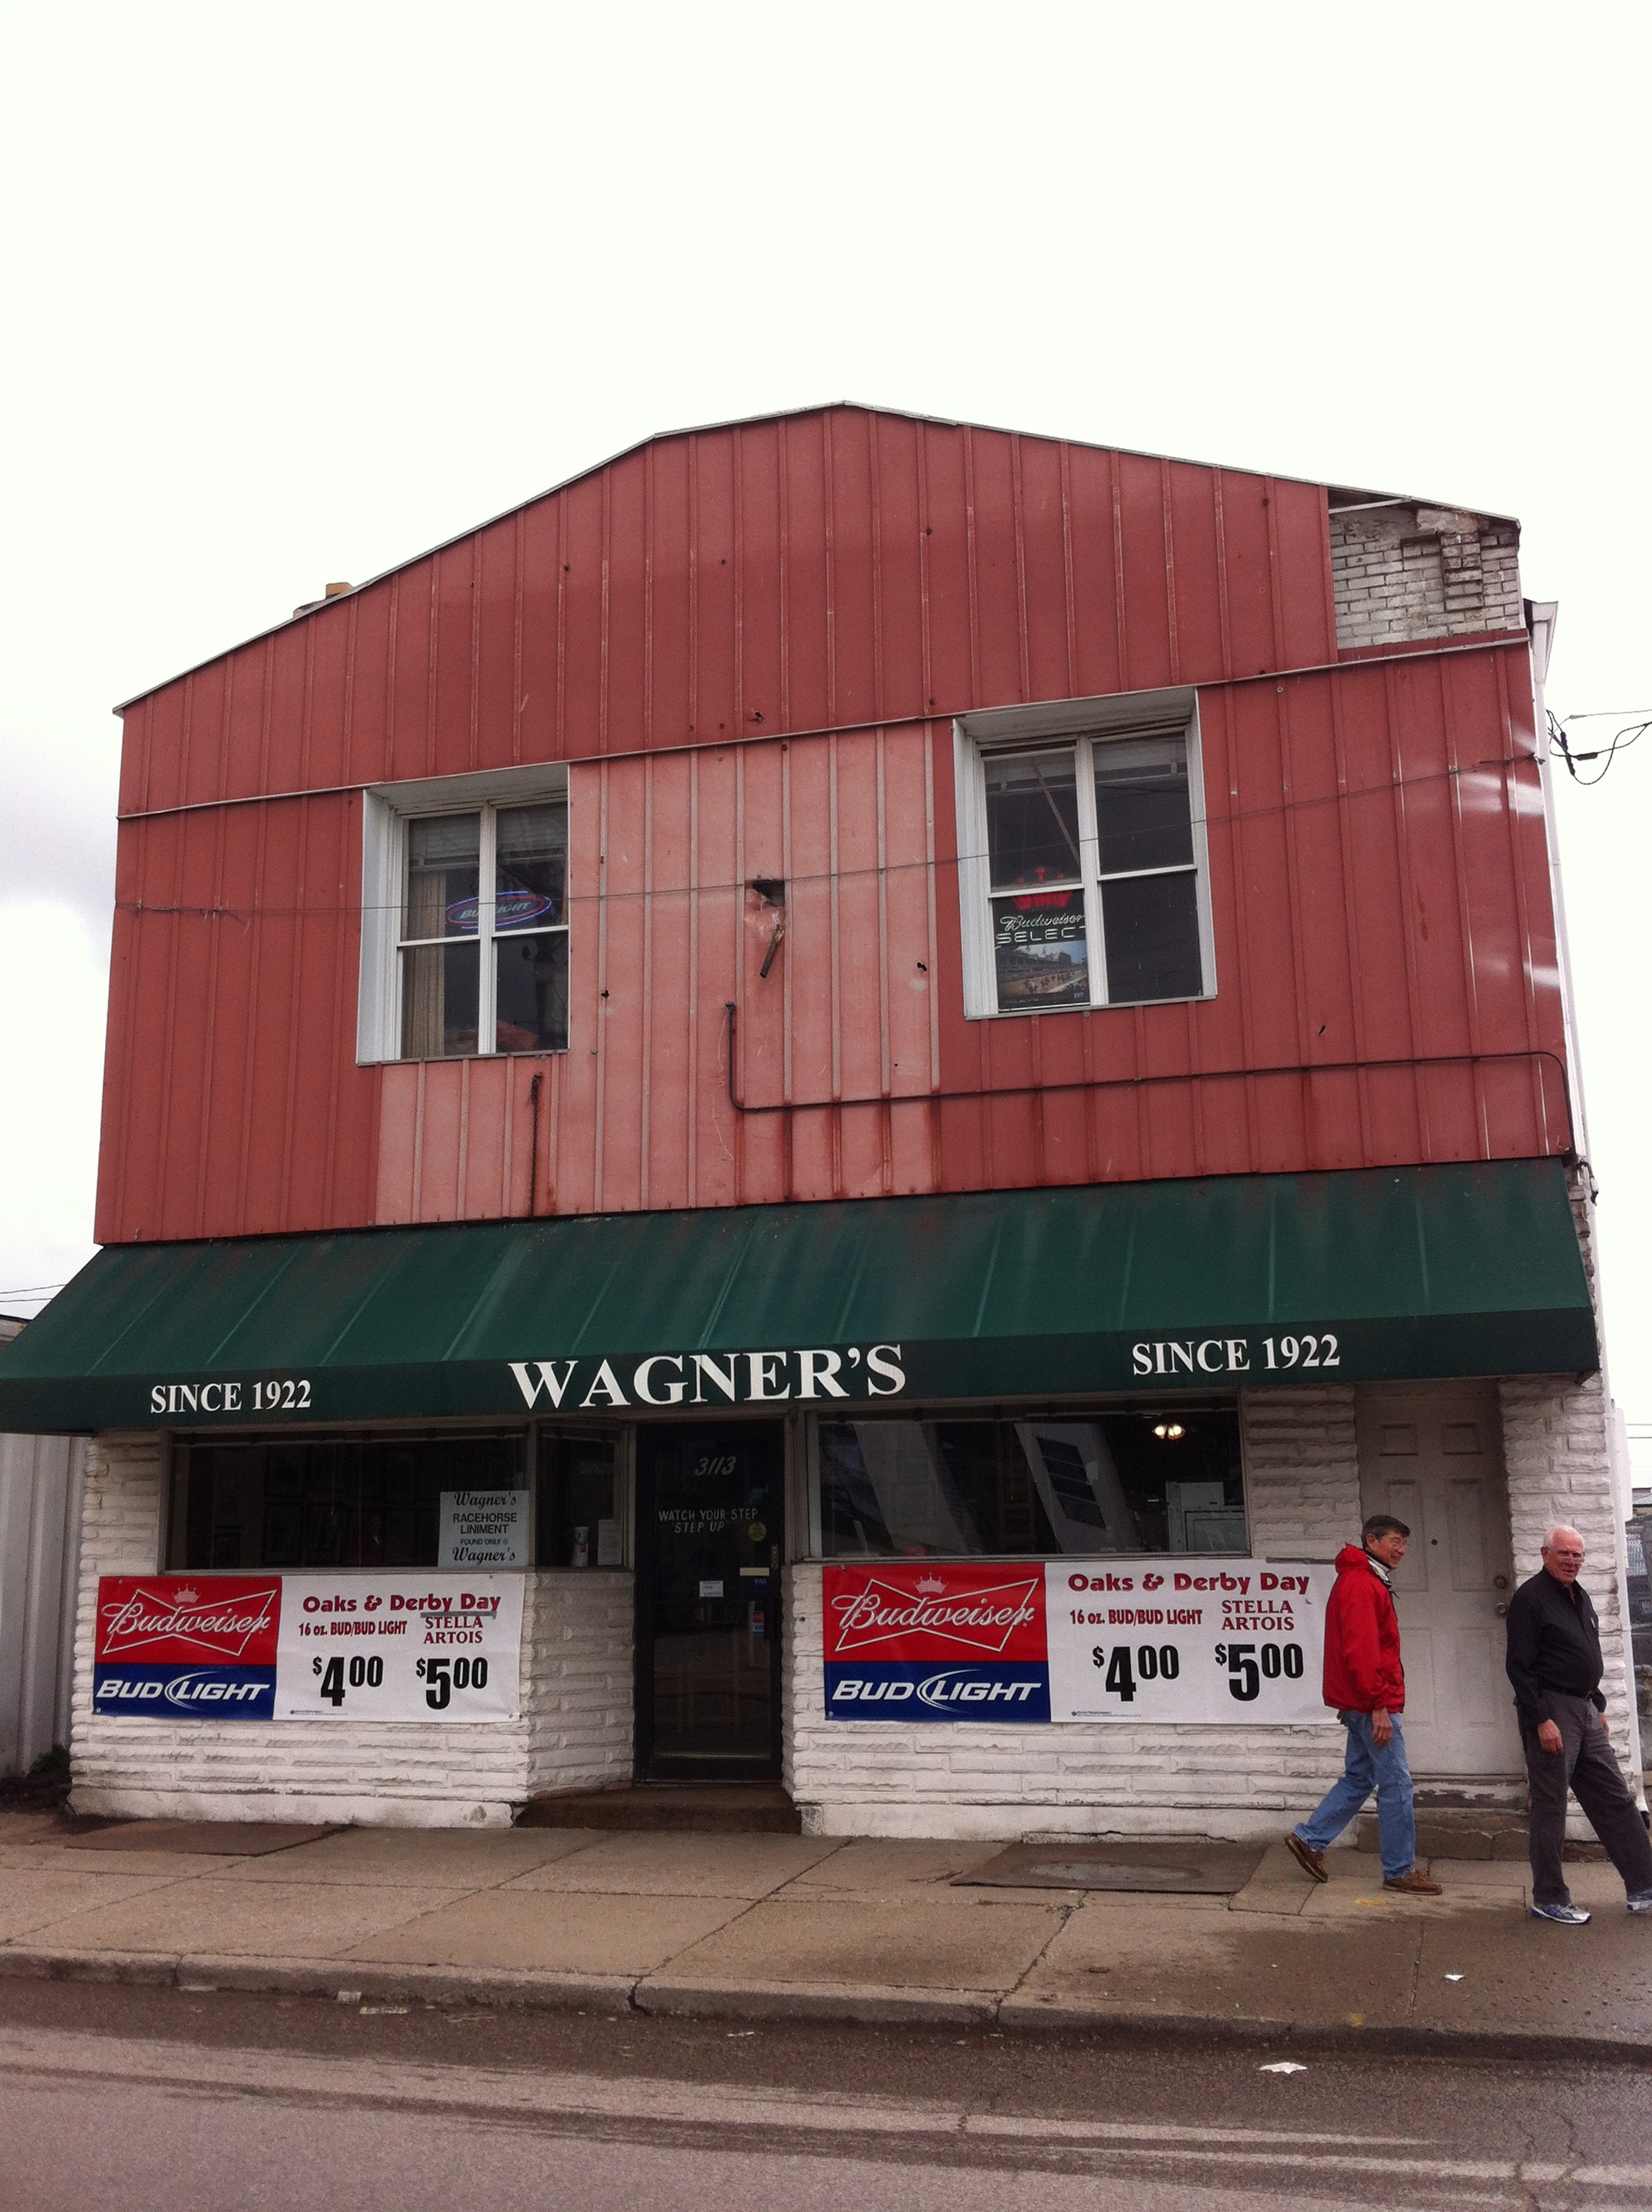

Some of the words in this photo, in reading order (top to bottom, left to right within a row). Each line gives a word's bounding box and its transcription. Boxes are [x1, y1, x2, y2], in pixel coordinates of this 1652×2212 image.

[460, 909, 480, 919] BU
[495, 902, 531, 914] IGHT
[1000, 913, 1085, 931] Budweiser
[1132, 1339, 1250, 1376] SINCE
[1262, 1334, 1341, 1369] 1922
[508, 1344, 905, 1410] WAGNER'S
[150, 1383, 242, 1413] SINCE
[252, 1380, 311, 1411] 1922
[695, 1456, 736, 1476] 3113
[454, 1492, 516, 1510] Wagner's
[453, 1513, 517, 1522] RACEHORSE
[659, 1511, 695, 1522] WATCH
[700, 1510, 726, 1521] YOUR
[730, 1508, 758, 1520] STEP
[460, 1525, 509, 1534] LINIMENT
[452, 1546, 515, 1565] Wagner's
[1068, 1574, 1133, 1592] Oaks
[1142, 1574, 1165, 1592] &
[1174, 1572, 1251, 1595] Derby
[1260, 1573, 1311, 1595] Day
[303, 1596, 357, 1613] Oaks
[364, 1595, 382, 1611] &
[390, 1594, 453, 1613] Derby
[461, 1593, 502, 1612] Day
[831, 1594, 1036, 1630] Budweiser
[1222, 1600, 1294, 1615] STELLA
[102, 1603, 271, 1634] Budweiser
[425, 1615, 484, 1629] STELLA
[1069, 1610, 1084, 1625] 16
[1088, 1612, 1106, 1625] oz.
[1108, 1610, 1164, 1627] BUD/BUD
[1166, 1610, 1203, 1625] LIGHT
[1222, 1616, 1295, 1632] ARTOIS
[299, 1622, 311, 1637] 16
[313, 1625, 328, 1636] oz.
[330, 1622, 375, 1637] BUD/BUD
[378, 1621, 408, 1635] LIGHT
[423, 1631, 484, 1644] ARTOIS
[96, 1679, 164, 1699] BUD
[175, 1680, 270, 1701] LIGHT
[832, 1680, 915, 1701] BUD
[931, 1682, 1042, 1702] LIGHT
